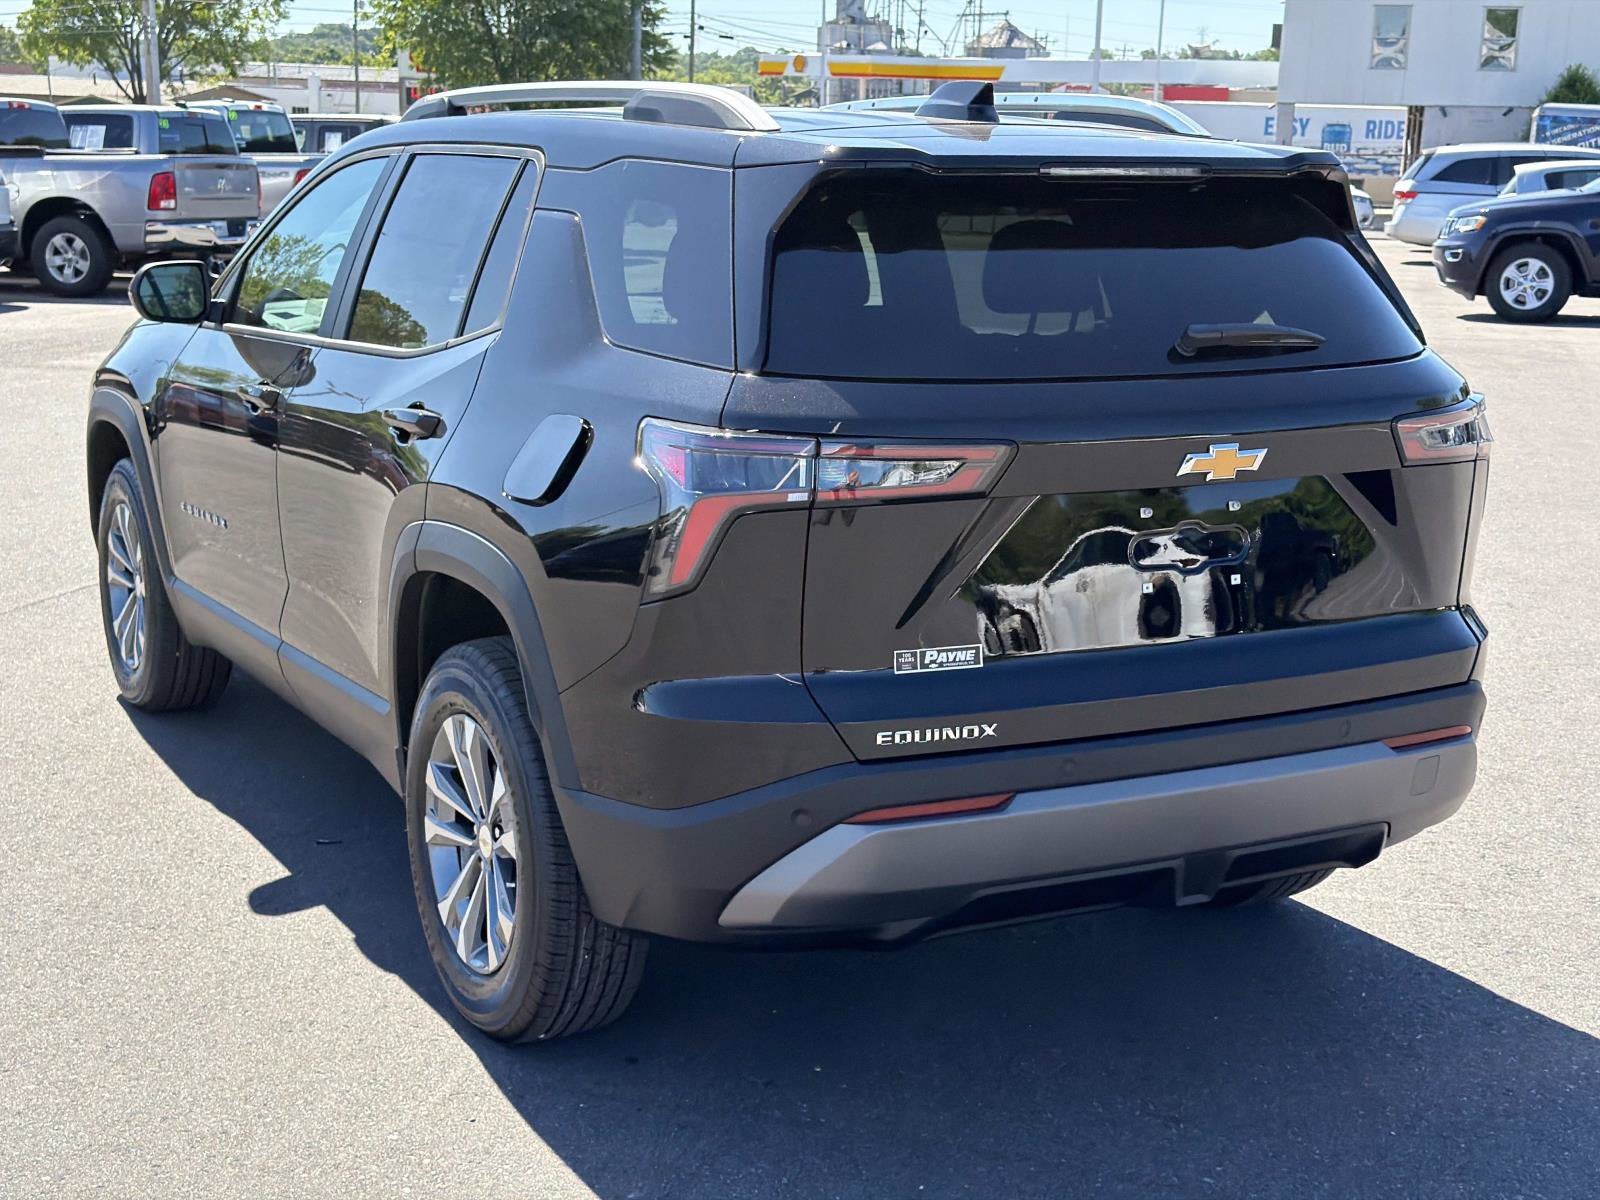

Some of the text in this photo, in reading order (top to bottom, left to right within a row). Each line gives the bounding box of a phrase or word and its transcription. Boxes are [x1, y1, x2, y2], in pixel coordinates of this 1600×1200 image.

[1264, 117, 1405, 139] ESY RIDE
[924, 650, 976, 664] PAYNE
[876, 723, 998, 745] EQUINOX
